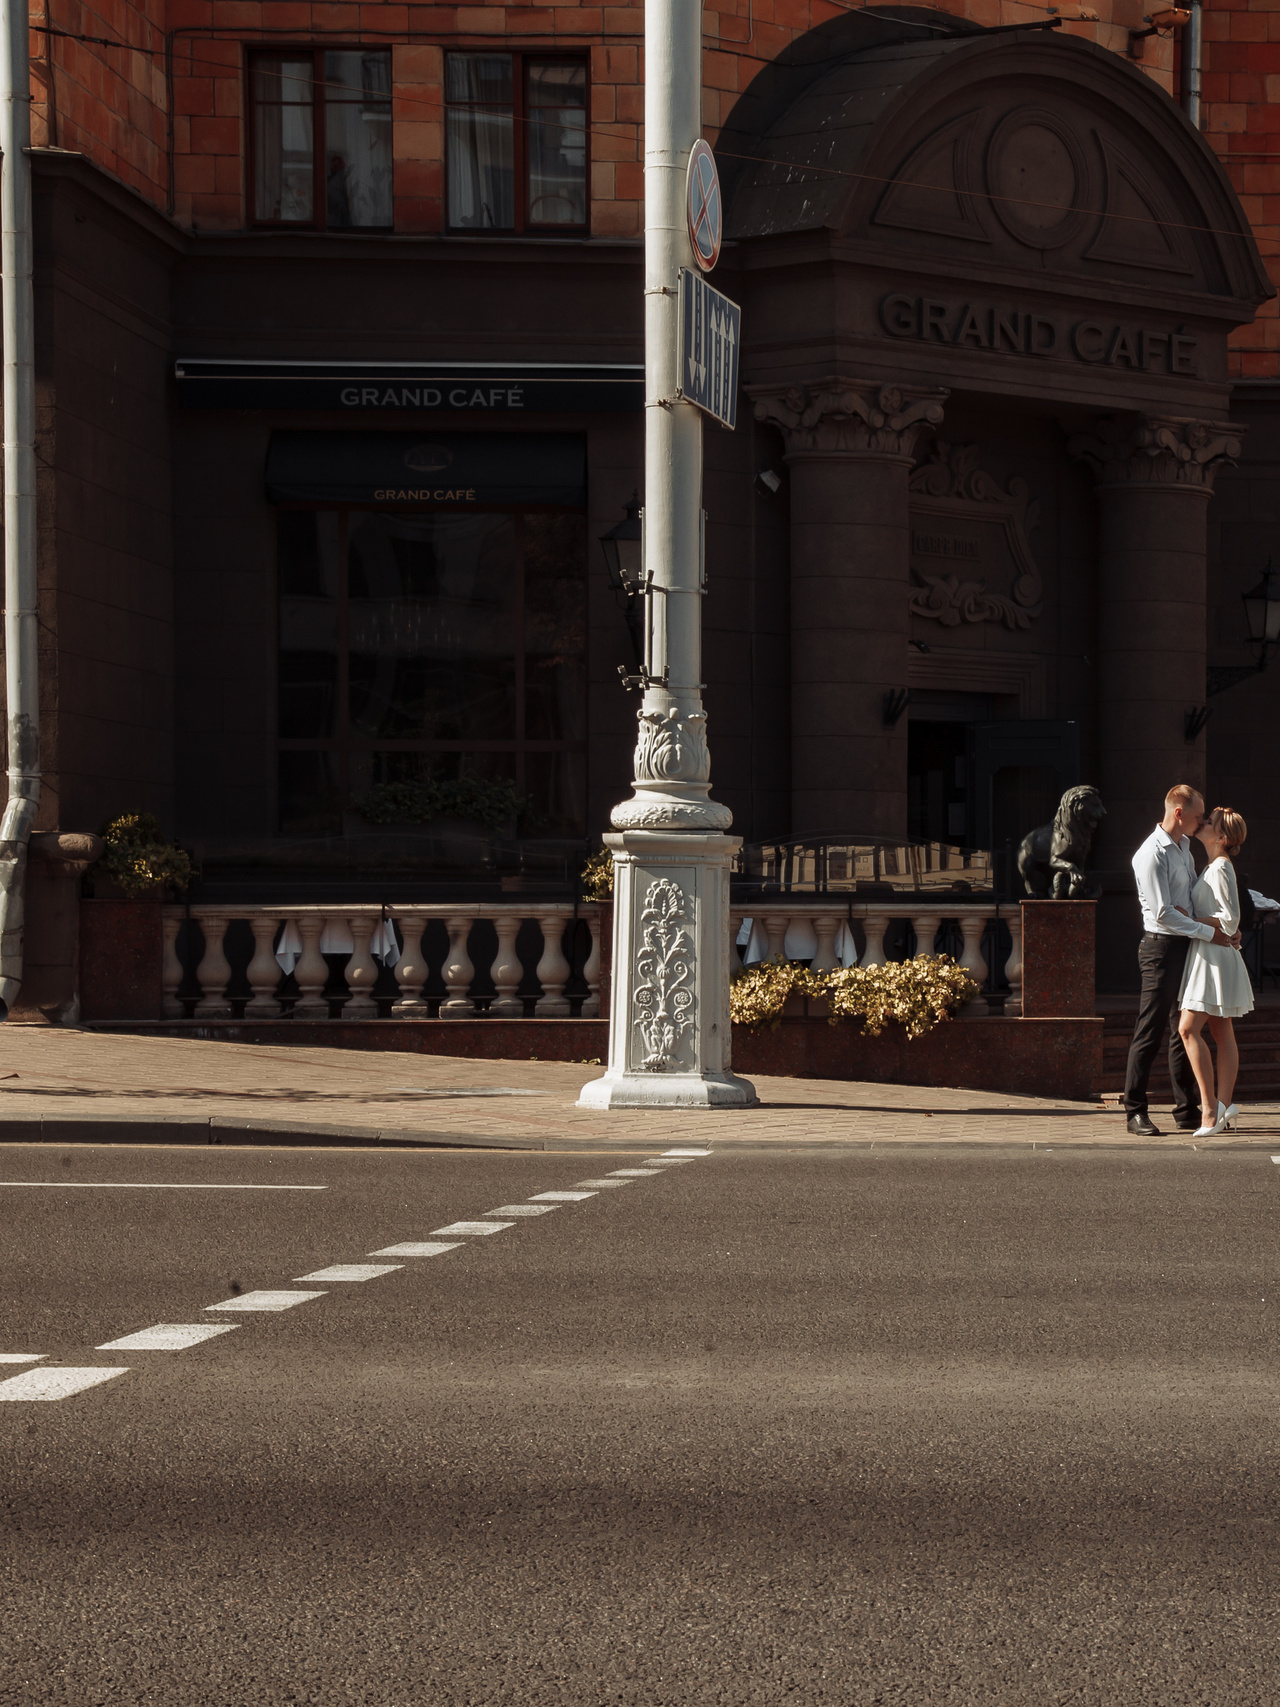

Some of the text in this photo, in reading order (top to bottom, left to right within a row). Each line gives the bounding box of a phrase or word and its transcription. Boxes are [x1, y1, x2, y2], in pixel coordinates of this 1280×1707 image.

[879, 292, 1198, 377] GRAND CAFÉ
[340, 385, 525, 407] GRAND CAFÉ
[374, 488, 477, 501] GRAND CAFÉ
